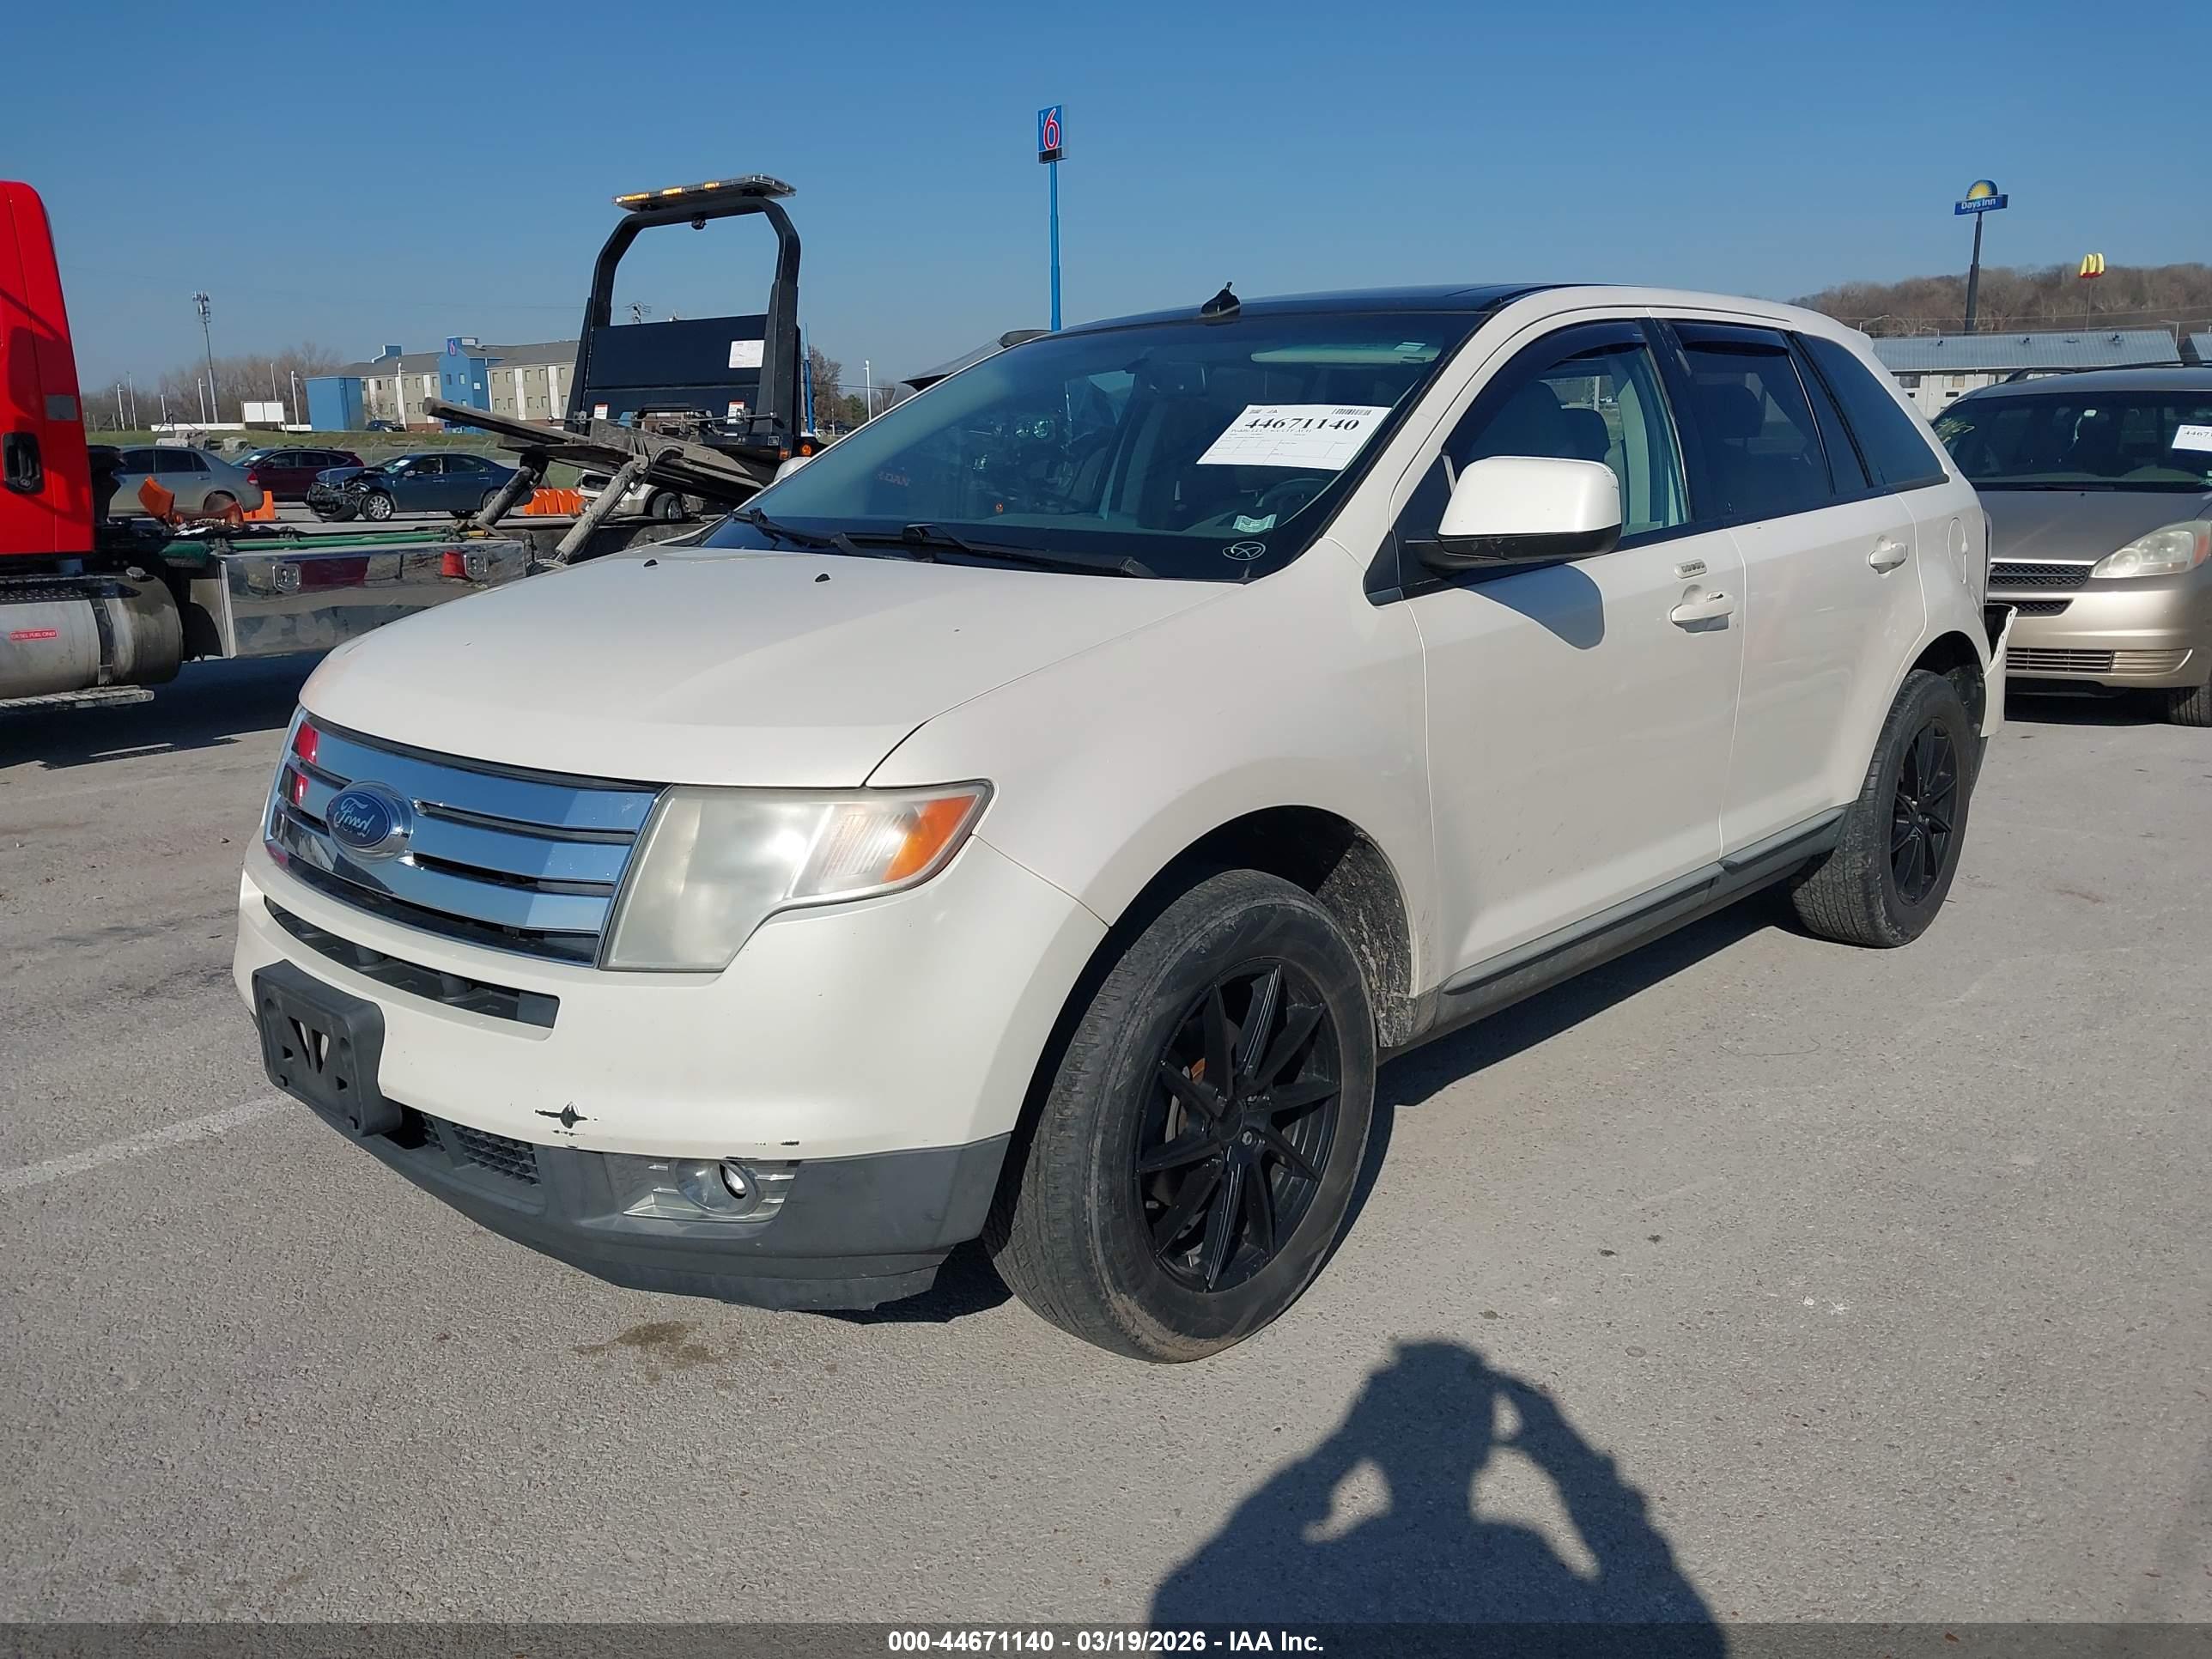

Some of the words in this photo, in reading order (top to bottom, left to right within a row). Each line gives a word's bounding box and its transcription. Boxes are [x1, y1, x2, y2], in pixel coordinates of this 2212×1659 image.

[1043, 107, 1060, 150] 6
[1960, 202, 1981, 210] Days
[1982, 198, 1996, 207] Inn
[1245, 418, 1359, 431] 44671140
[333, 797, 375, 832] Ford
